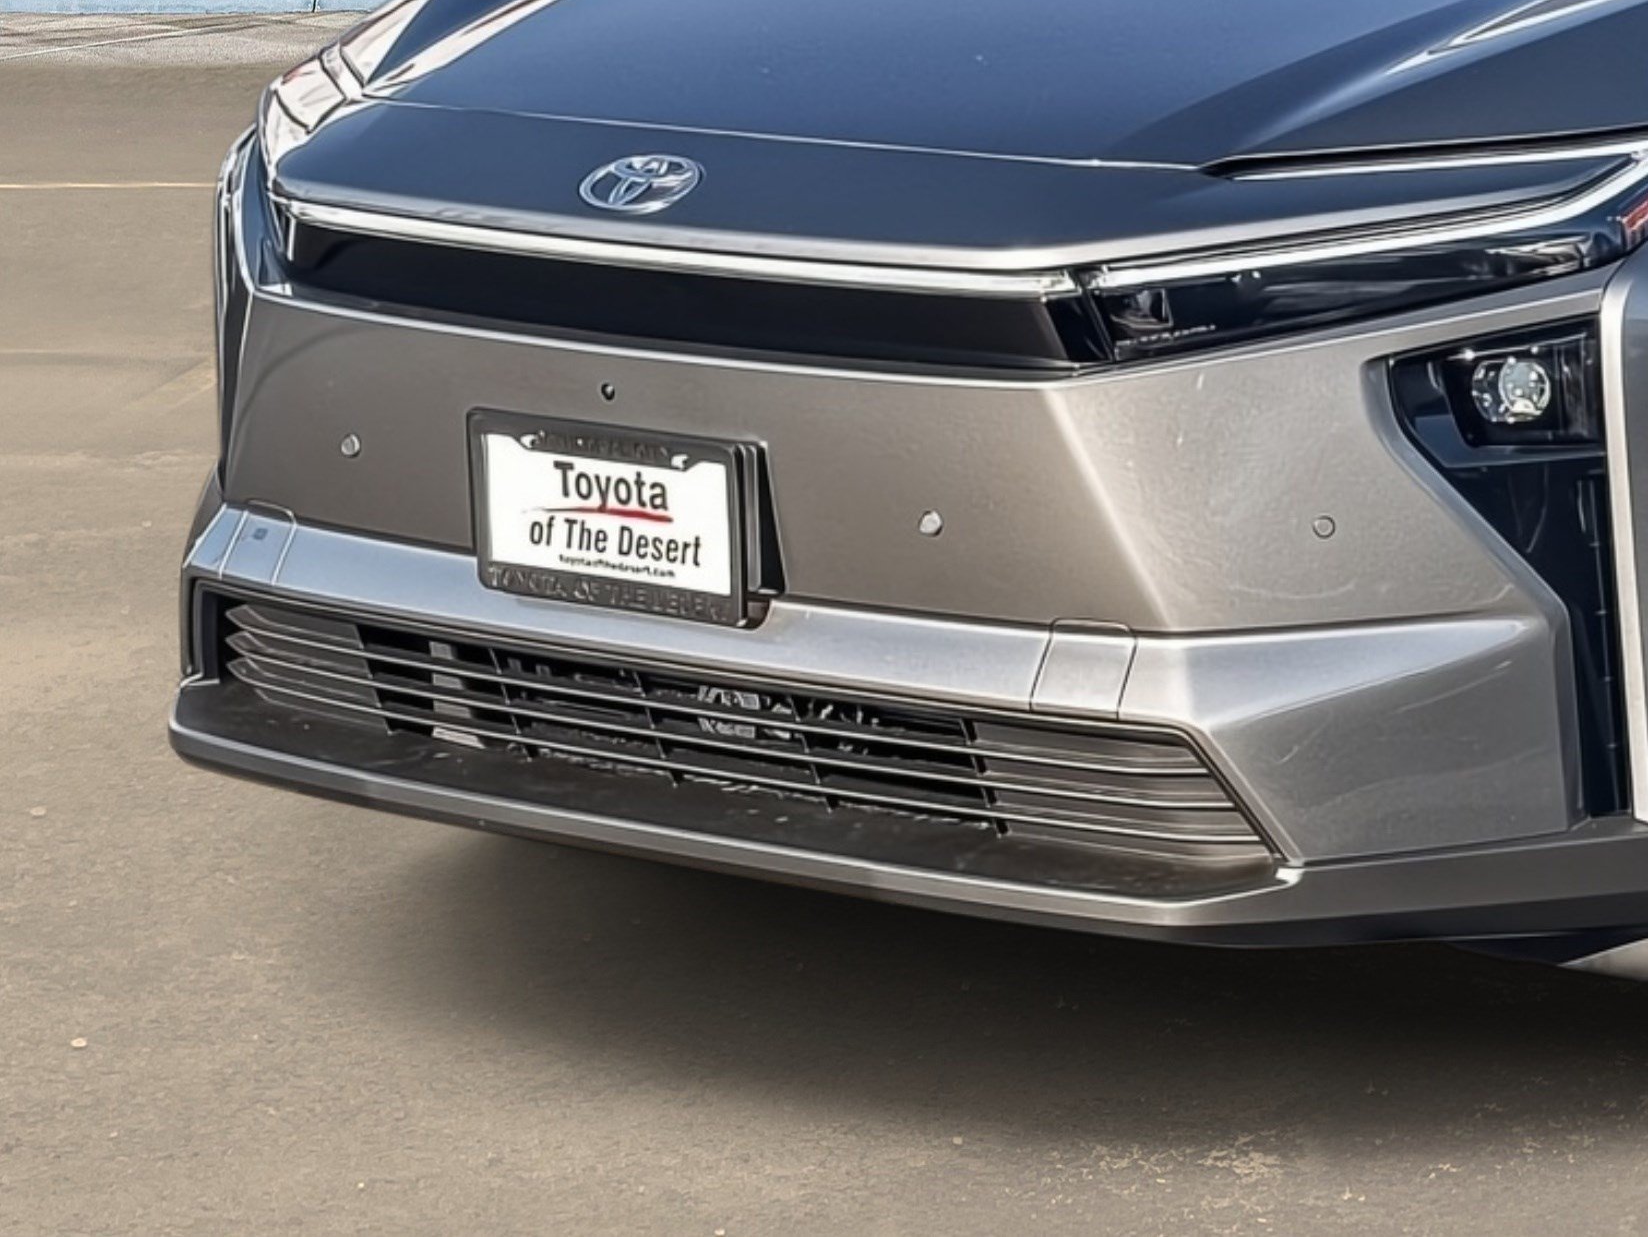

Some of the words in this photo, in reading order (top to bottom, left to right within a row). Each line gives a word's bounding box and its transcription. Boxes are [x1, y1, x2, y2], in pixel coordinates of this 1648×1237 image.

[553, 460, 669, 512] Toyota
[529, 515, 556, 546] of
[564, 517, 609, 553] The
[618, 524, 702, 567] Desert
